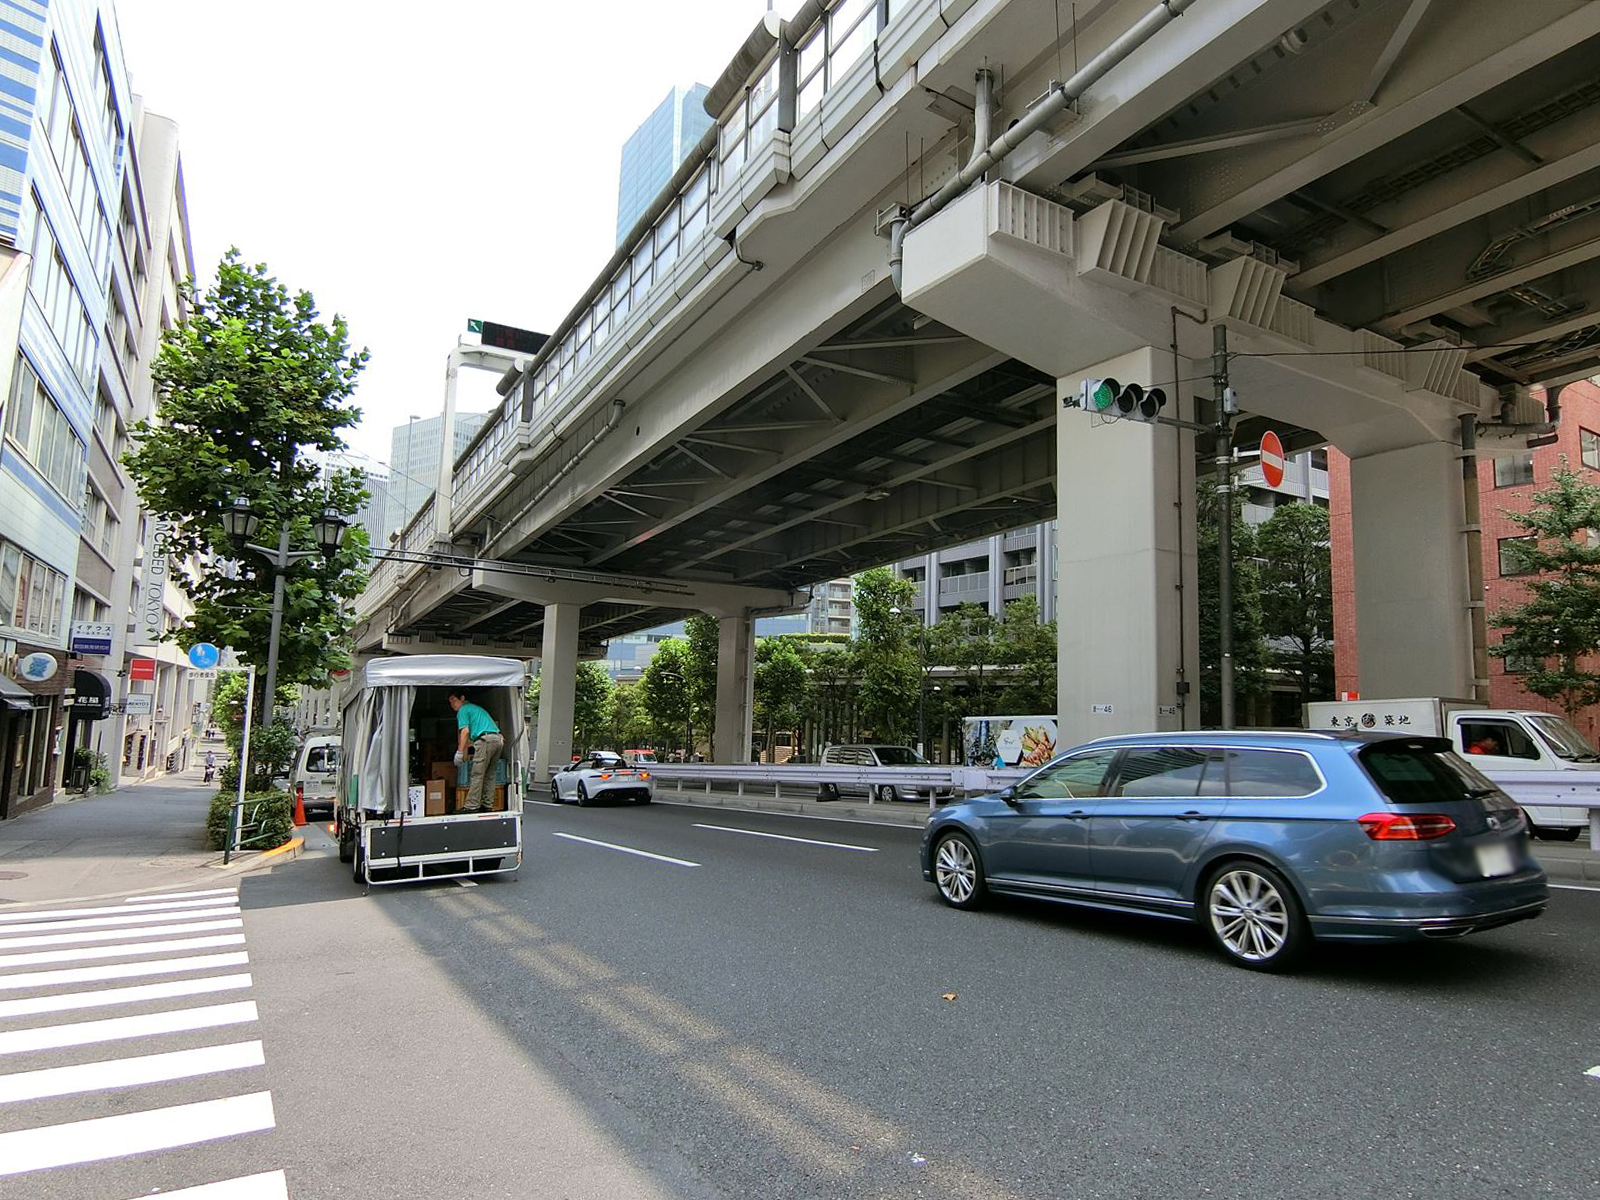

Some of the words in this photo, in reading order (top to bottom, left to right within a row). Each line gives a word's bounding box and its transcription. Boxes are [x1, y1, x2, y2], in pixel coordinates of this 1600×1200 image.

[145, 582, 162, 626] TOKYO
[1330, 715, 1354, 727] 東京
[1384, 714, 1411, 727] 築地
